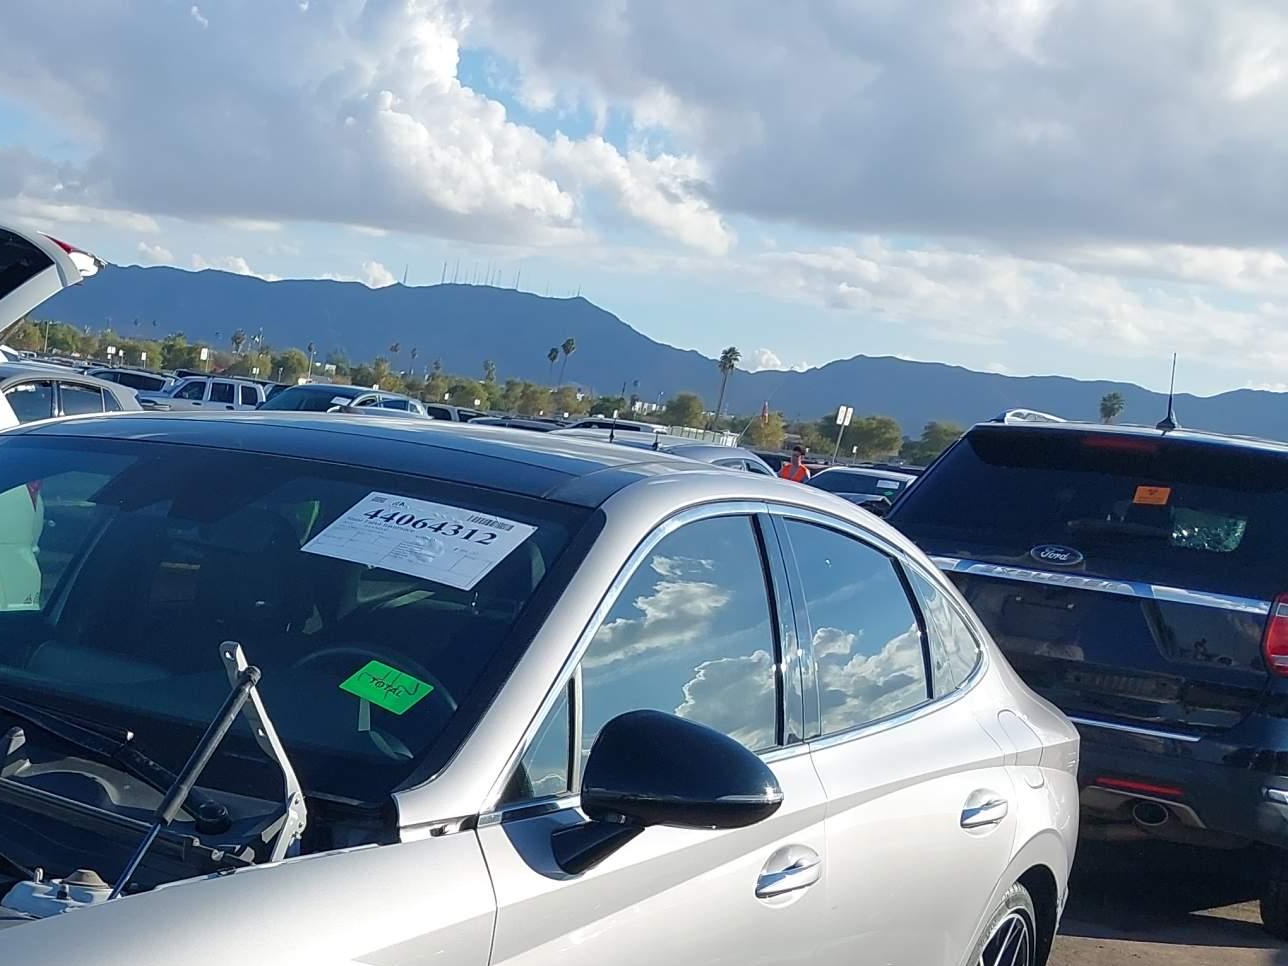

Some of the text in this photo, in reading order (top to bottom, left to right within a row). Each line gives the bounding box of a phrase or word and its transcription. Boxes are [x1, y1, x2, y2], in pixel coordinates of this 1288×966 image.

[363, 508, 498, 546] 44064312
[1040, 547, 1071, 562] Ford
[370, 676, 404, 698] TOTAL
